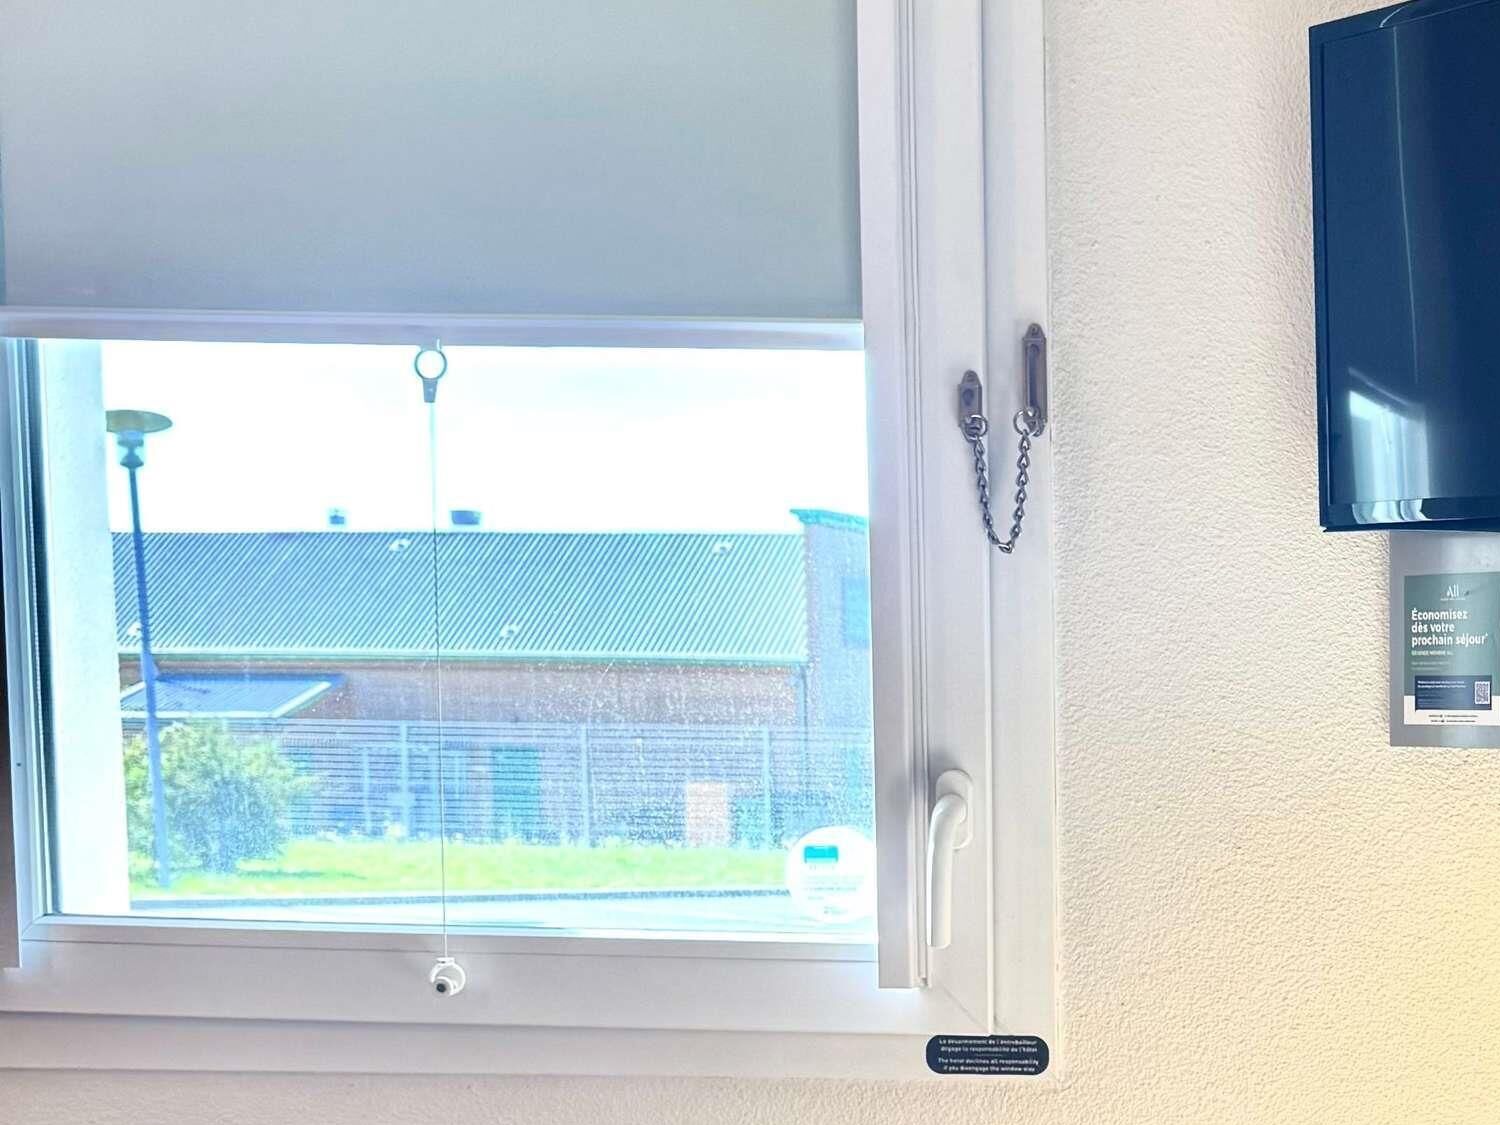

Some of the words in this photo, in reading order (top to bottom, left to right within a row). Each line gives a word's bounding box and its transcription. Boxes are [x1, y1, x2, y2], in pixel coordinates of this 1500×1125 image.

[1411, 607, 1468, 621] Économisez
[1411, 621, 1428, 633] dès
[1429, 622, 1456, 633] votre
[1411, 633, 1453, 648] prochain
